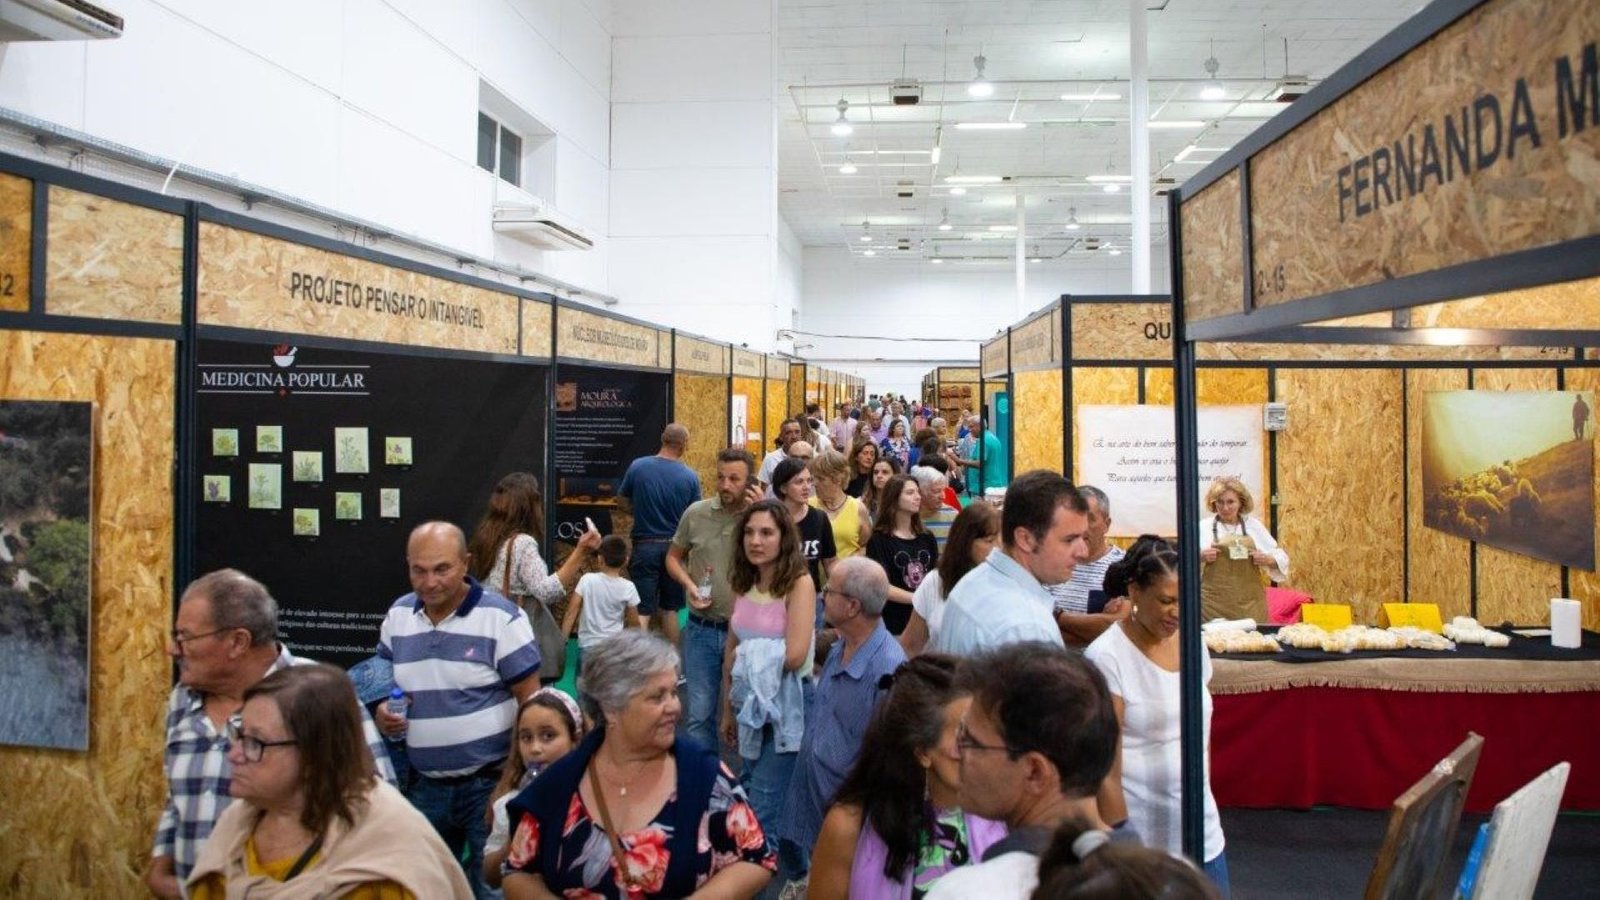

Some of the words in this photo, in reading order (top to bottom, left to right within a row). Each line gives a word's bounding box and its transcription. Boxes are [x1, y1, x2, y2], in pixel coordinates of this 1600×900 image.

[1338, 77, 1541, 223] FERNANDA
[291, 272, 362, 308] PROJETO
[366, 287, 415, 318] PENSAR
[418, 301, 427, 320] O
[202, 372, 284, 387] MEDICINA
[289, 373, 365, 388] POPULAR
[580, 391, 618, 400] MOURA
